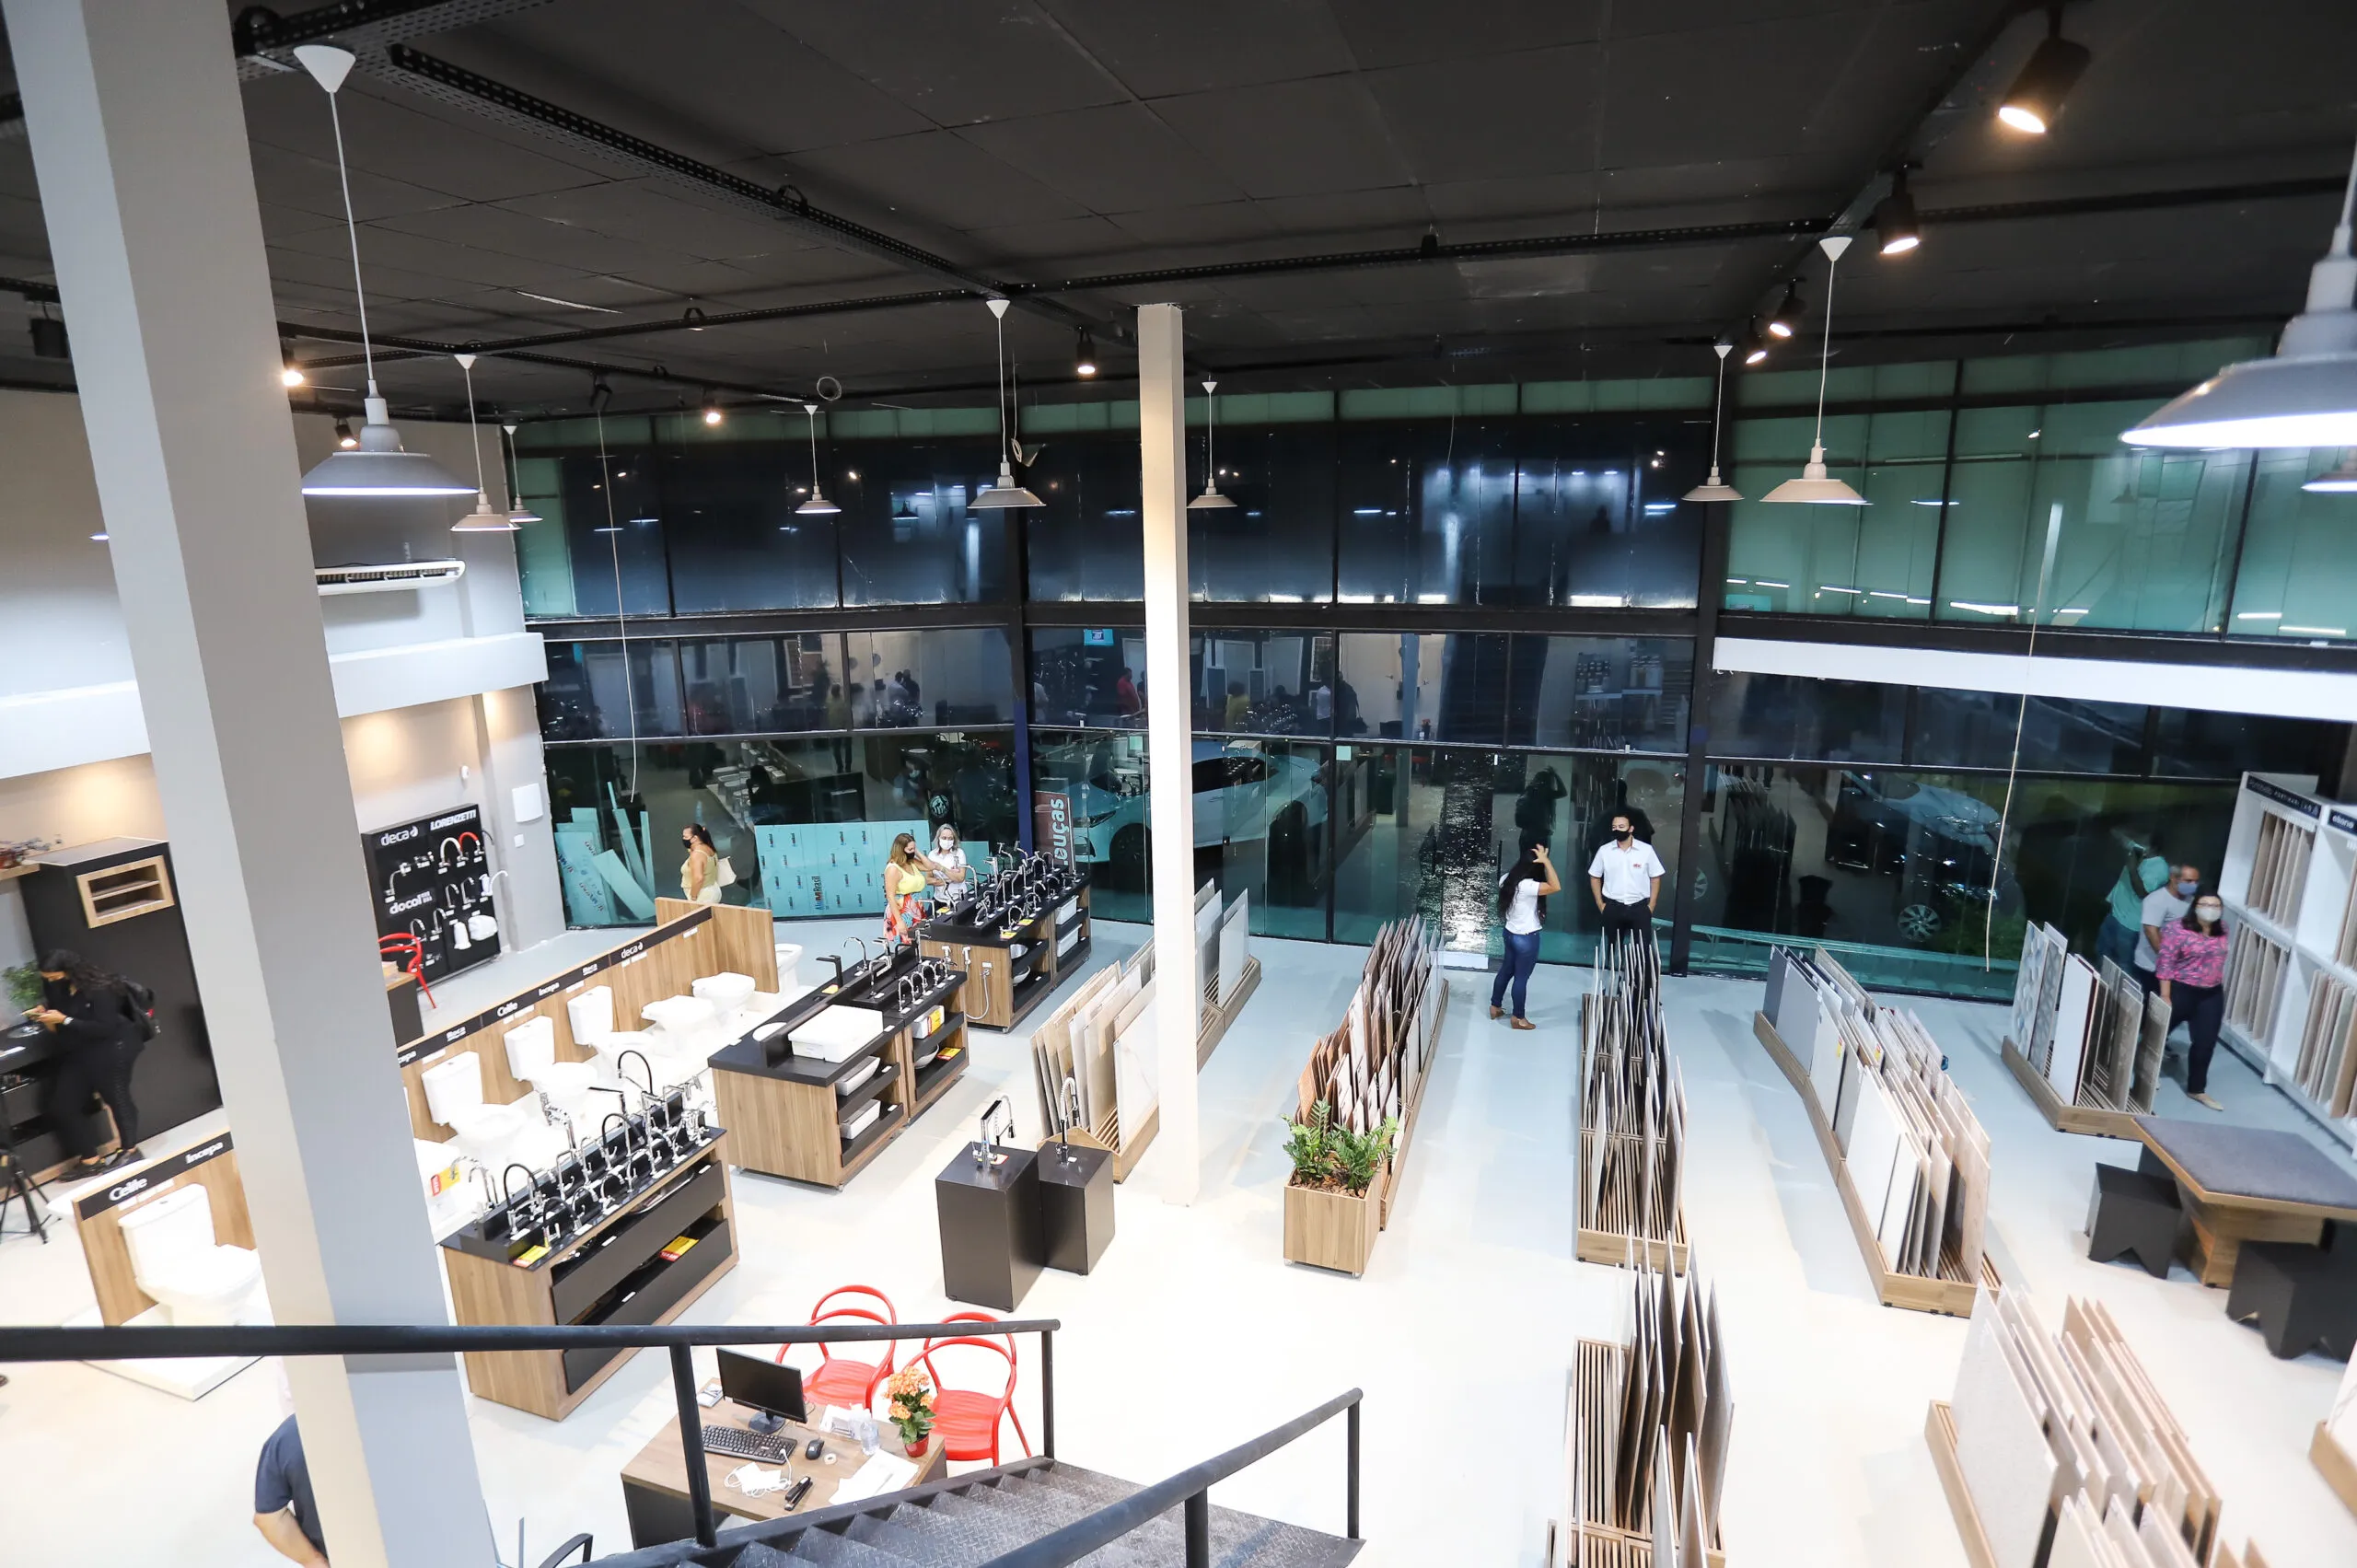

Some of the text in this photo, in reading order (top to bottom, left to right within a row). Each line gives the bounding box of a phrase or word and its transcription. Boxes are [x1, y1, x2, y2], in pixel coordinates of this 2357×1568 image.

[430, 809, 477, 830] LORENZETTI
[380, 830, 410, 846] deca
[1051, 798, 1070, 865] ouças
[389, 893, 423, 914] docol
[621, 944, 639, 958] deca
